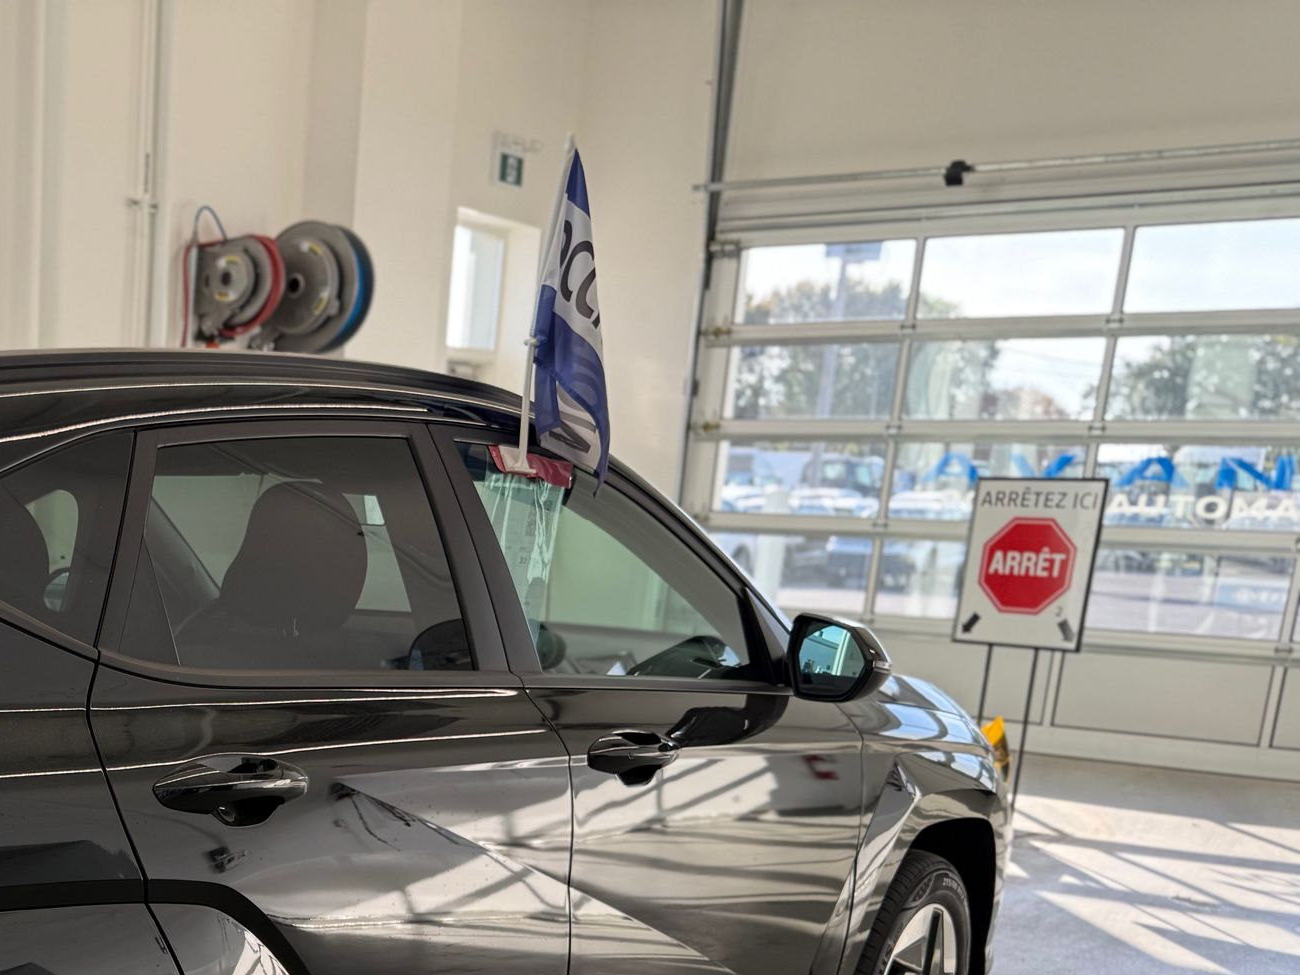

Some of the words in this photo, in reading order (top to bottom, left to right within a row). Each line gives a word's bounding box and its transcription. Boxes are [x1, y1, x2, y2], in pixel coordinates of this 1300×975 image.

[980, 486, 1068, 510] ARRÊTEZ
[1072, 492, 1099, 510] ICI
[988, 547, 1067, 579] ARRÊT
